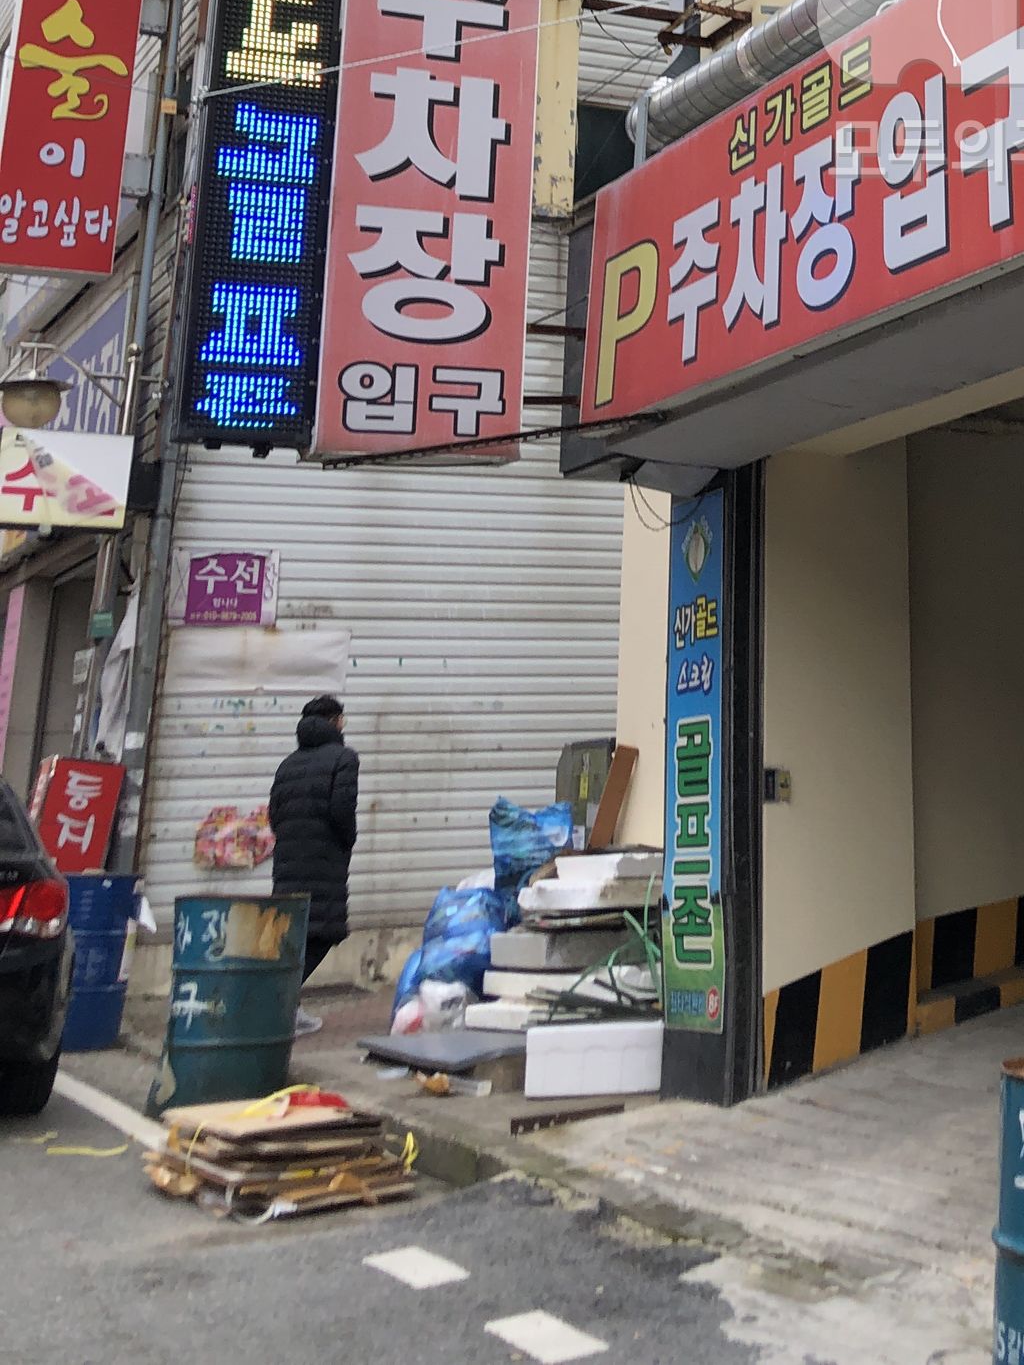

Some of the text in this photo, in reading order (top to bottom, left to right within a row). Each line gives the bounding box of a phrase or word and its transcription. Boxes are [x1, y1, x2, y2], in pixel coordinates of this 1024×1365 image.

[728, 35, 873, 175] 신가골드
[0, 187, 113, 248] 알고싶다
[594, 239, 660, 410] P
[666, 124, 862, 365] 주차장
[337, 361, 506, 438] 입구
[194, 557, 260, 595] 수선
[674, 594, 719, 649] 신가골드
[672, 719, 713, 966] 골프존
